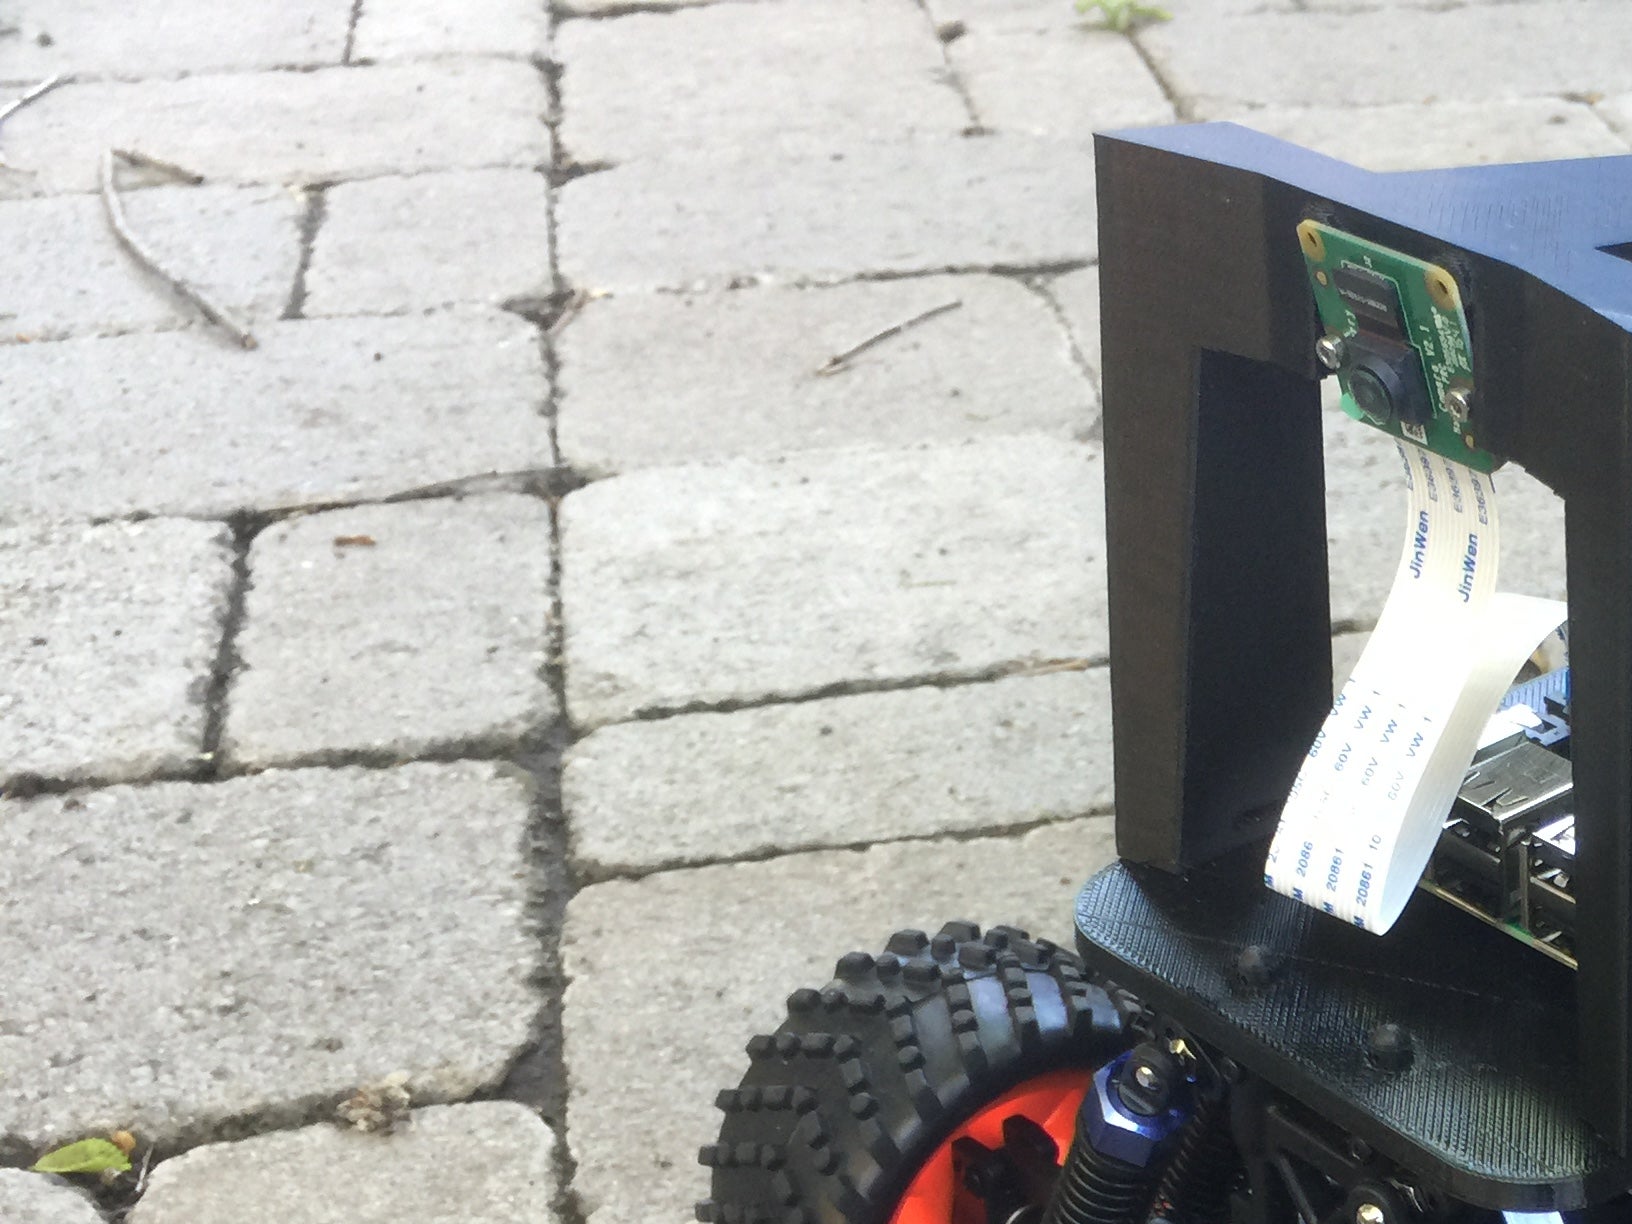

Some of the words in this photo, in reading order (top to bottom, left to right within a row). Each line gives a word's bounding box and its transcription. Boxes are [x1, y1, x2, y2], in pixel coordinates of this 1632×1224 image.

[1410, 511, 1429, 579] JinWen
[1458, 533, 1478, 603] JinWen
[1334, 742, 1352, 772] 60V
[1326, 848, 1345, 892] 20861
[1361, 756, 1379, 786] 60V
[1356, 862, 1374, 907] 20861
